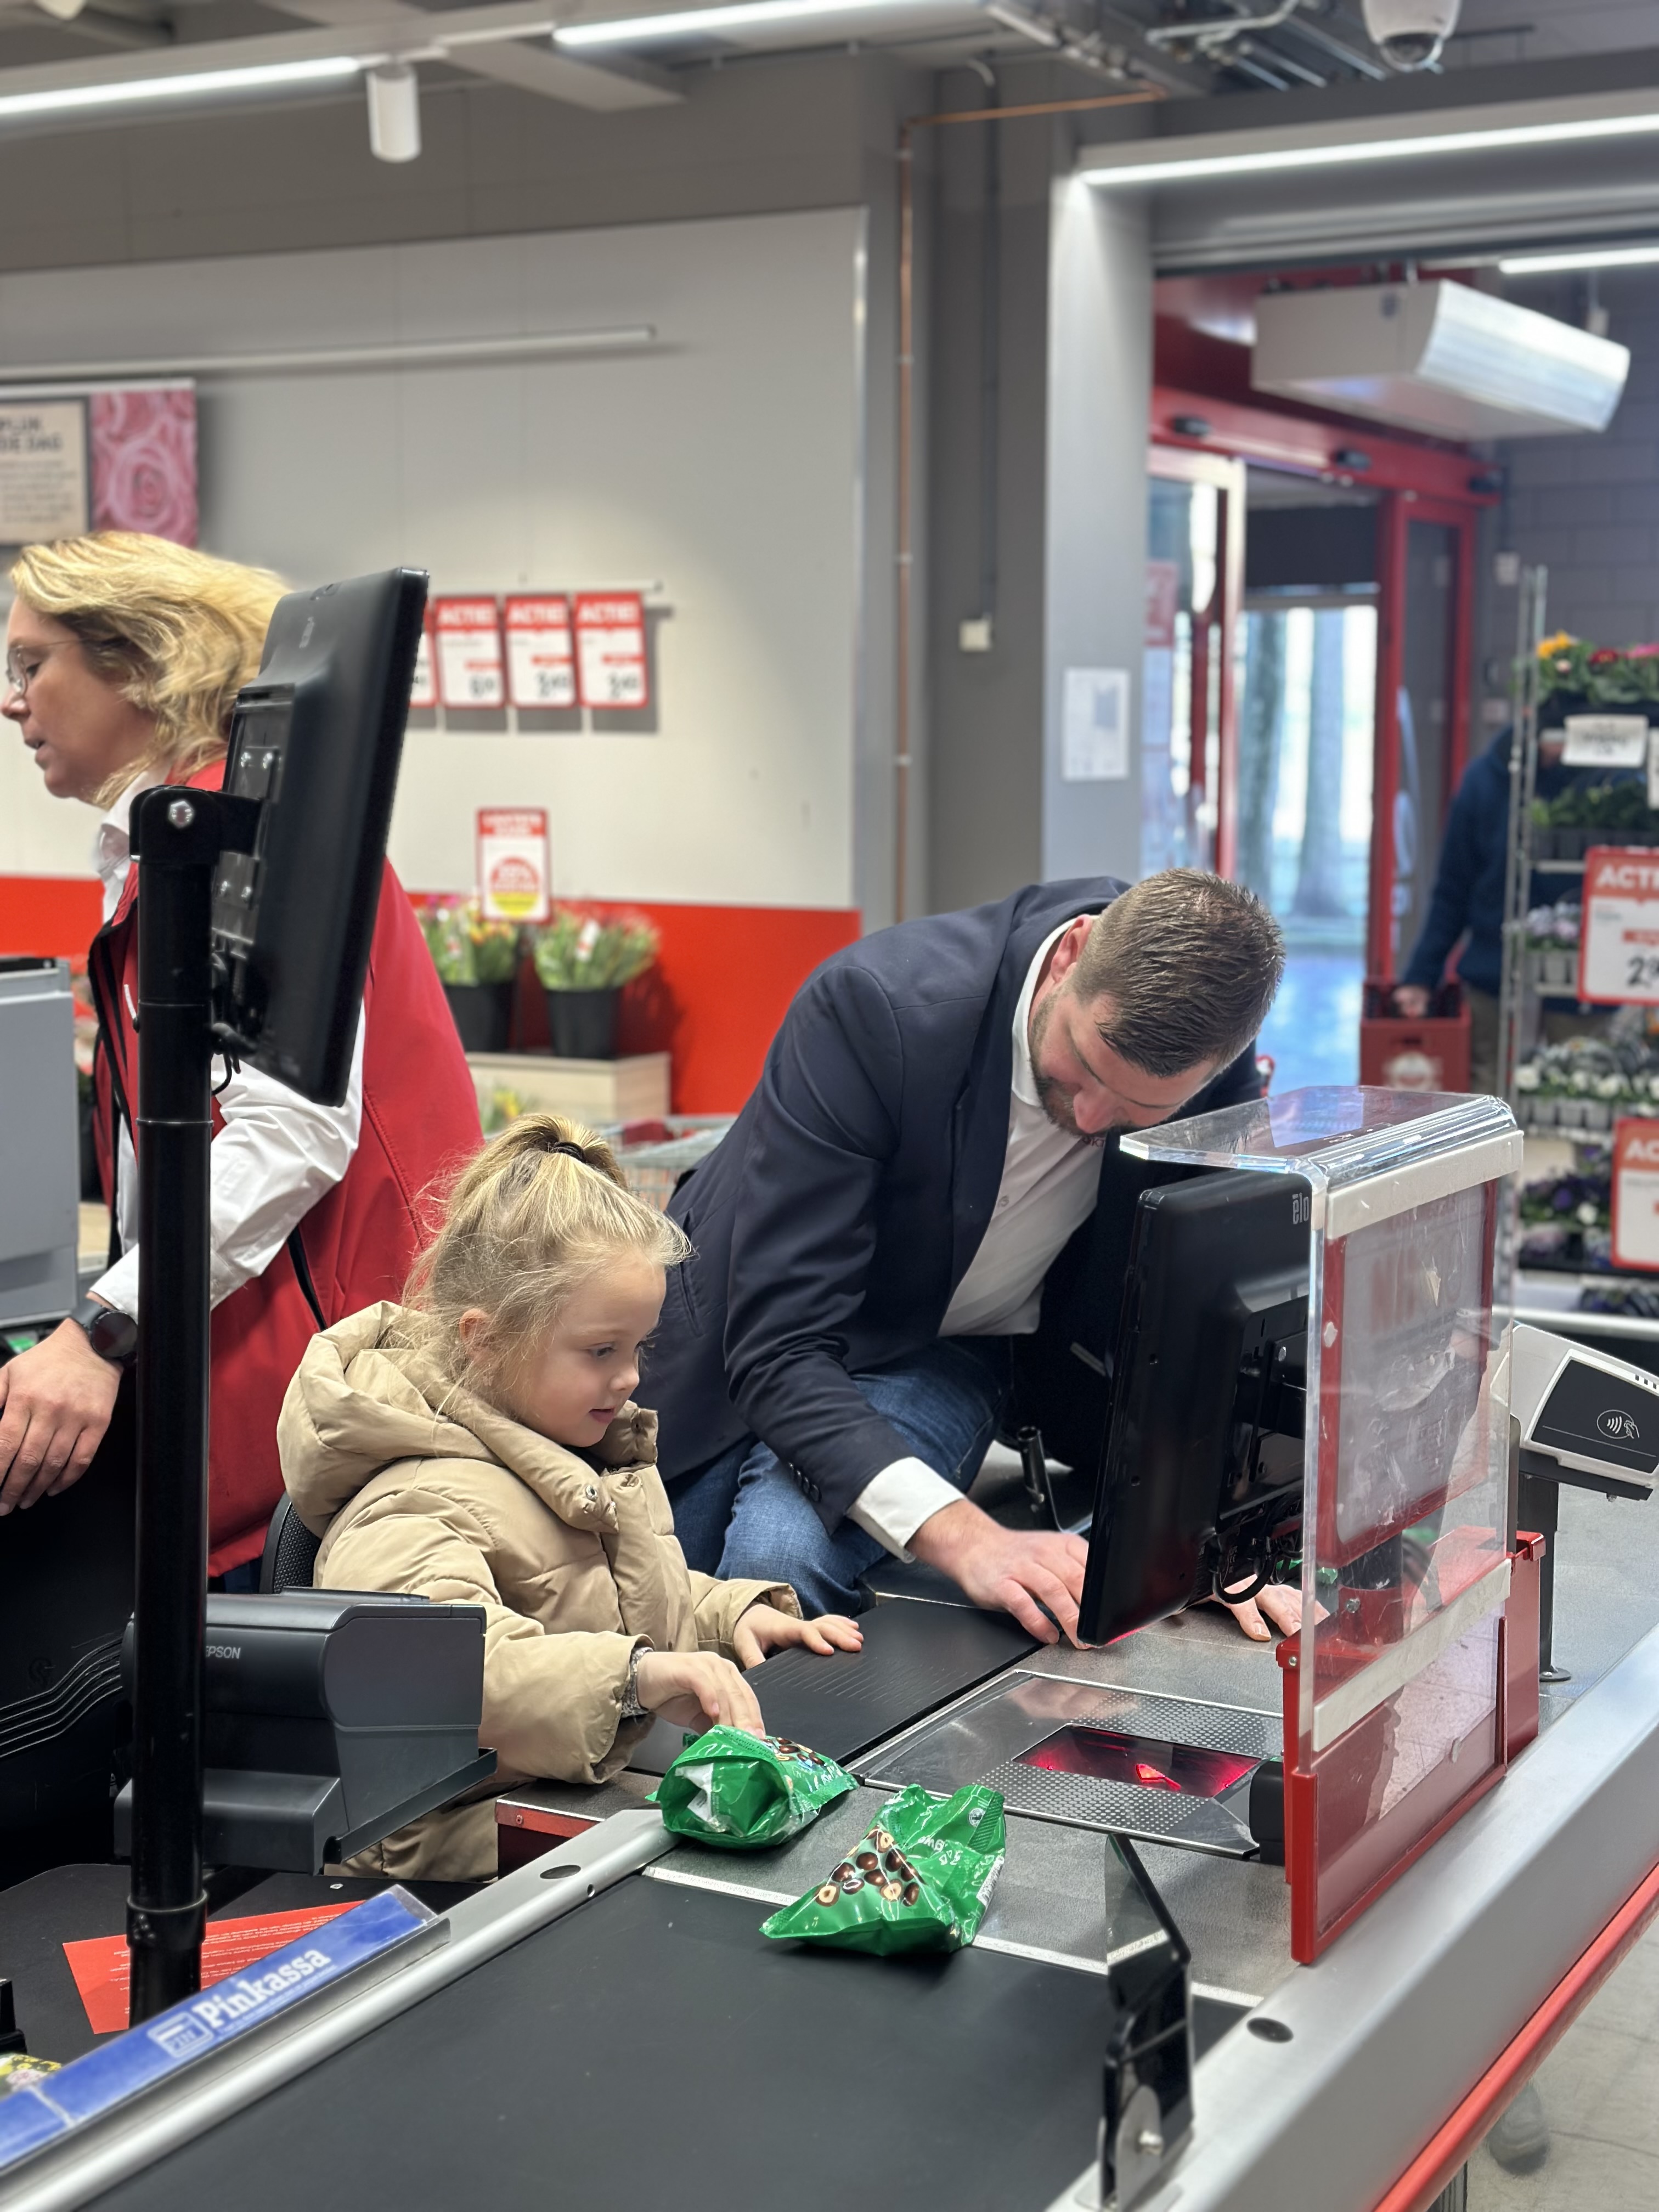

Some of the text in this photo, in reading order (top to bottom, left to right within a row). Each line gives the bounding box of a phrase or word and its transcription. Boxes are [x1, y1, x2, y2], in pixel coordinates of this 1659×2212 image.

[579, 602, 637, 623] ACTIE
[1292, 1192, 1310, 1224] elo
[192, 1949, 332, 2029] Pinkassa
